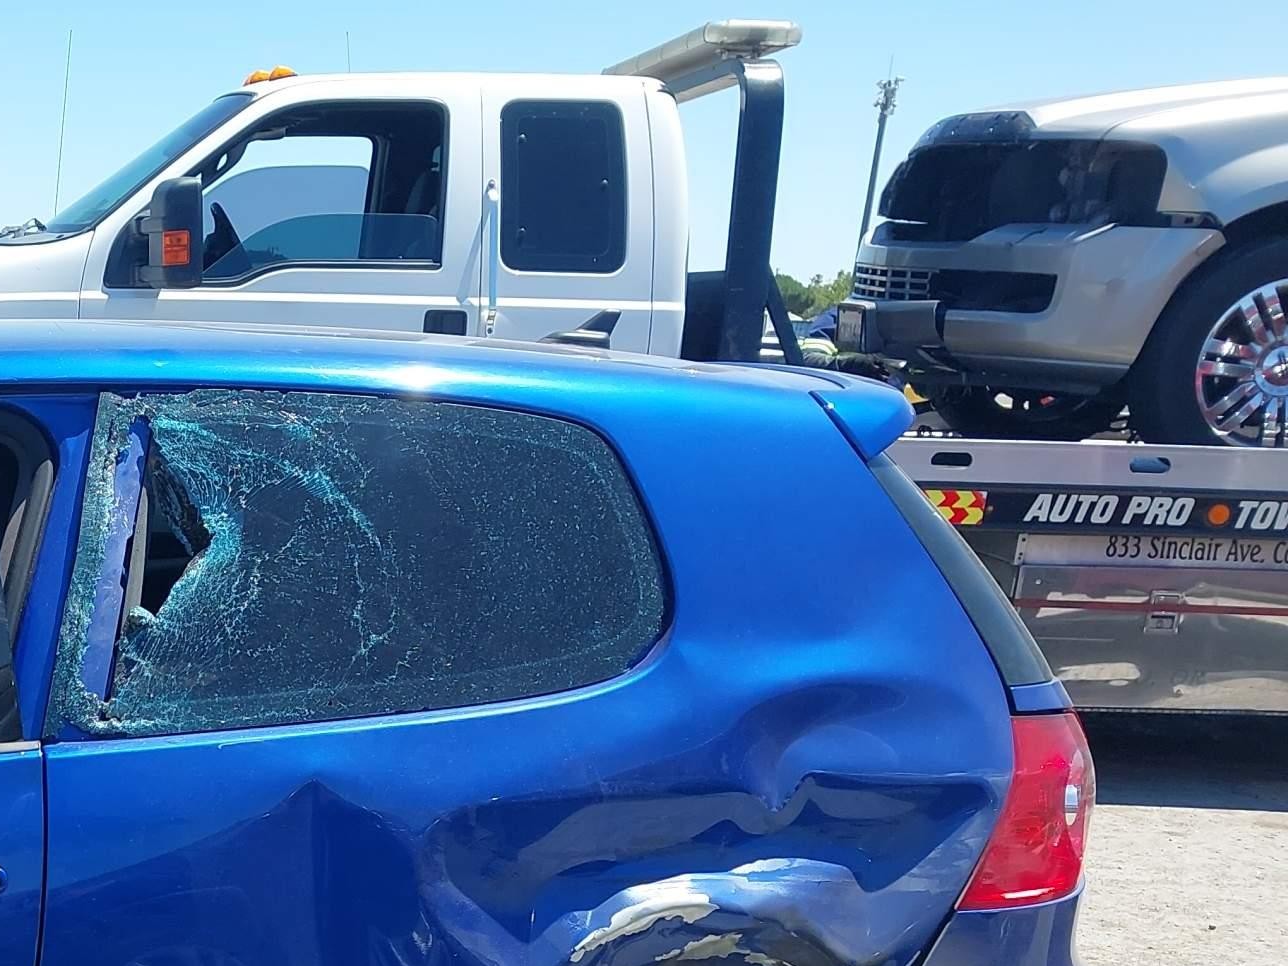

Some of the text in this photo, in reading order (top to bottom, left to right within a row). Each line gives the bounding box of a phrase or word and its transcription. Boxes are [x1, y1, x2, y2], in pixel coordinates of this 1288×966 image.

[1023, 494, 1120, 524] AUTO
[1121, 496, 1196, 526] PRO
[1106, 536, 1141, 558] 833
[1147, 536, 1223, 561] Sinclair
[1225, 539, 1265, 563] Ave.
